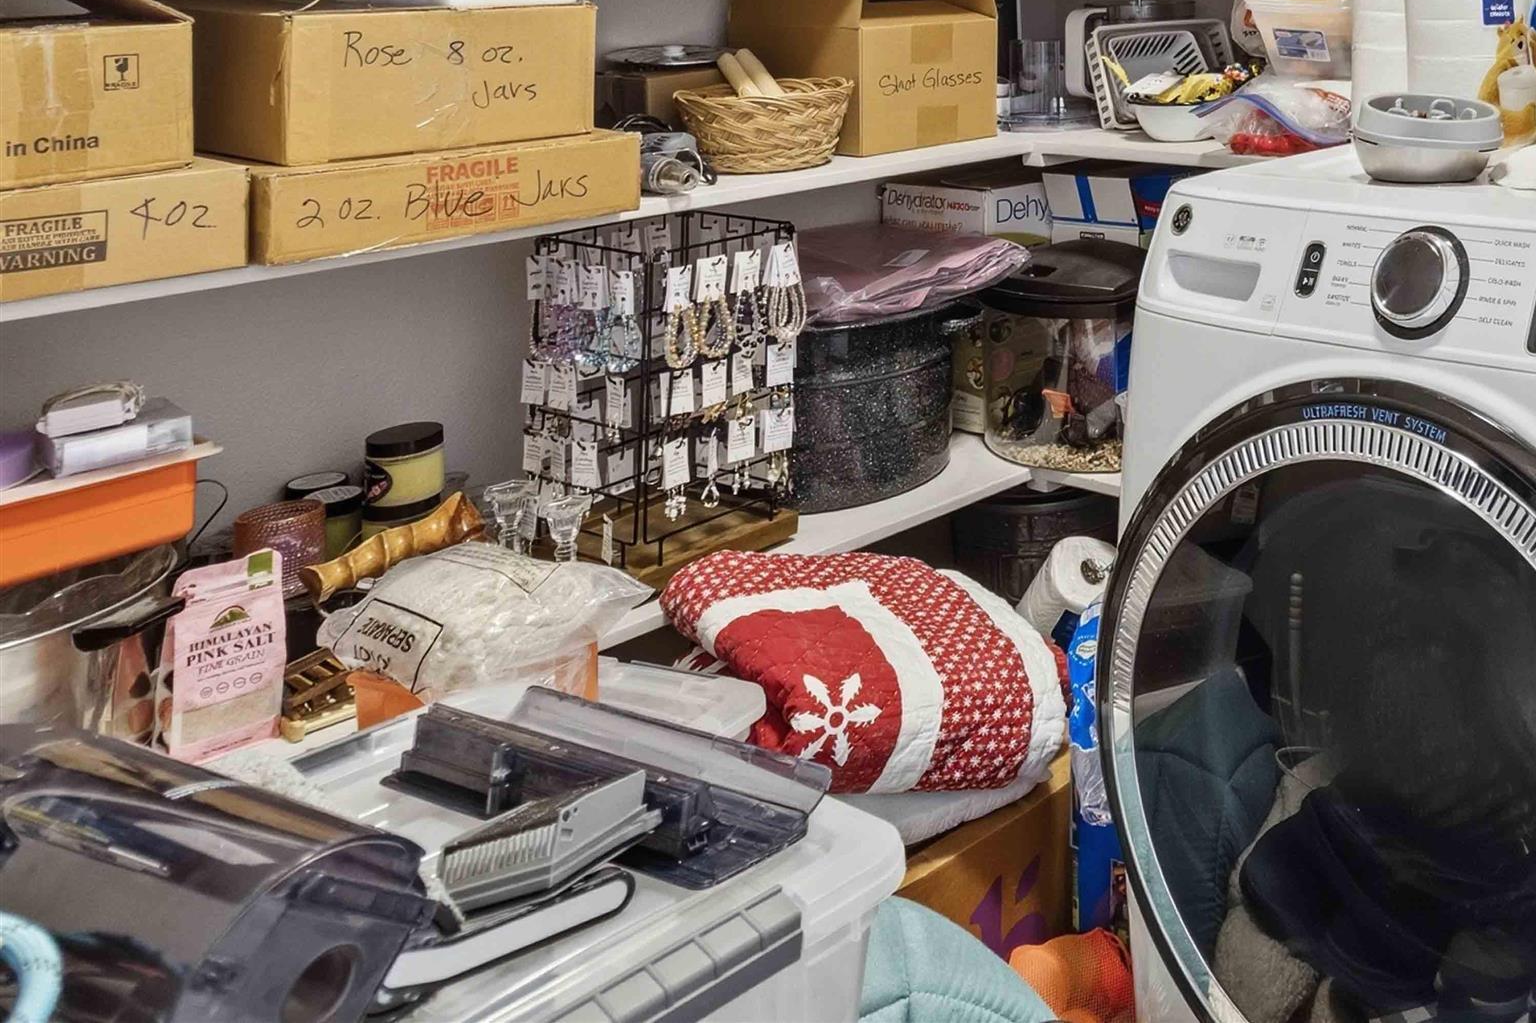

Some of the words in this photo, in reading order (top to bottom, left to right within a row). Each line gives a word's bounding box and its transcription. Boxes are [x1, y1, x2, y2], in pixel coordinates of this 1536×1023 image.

[344, 31, 412, 68] Rose
[446, 40, 465, 65] 8
[879, 72, 918, 96] Shot
[923, 68, 982, 89] Glasses
[6, 141, 27, 157] in
[34, 134, 99, 154] China
[426, 157, 519, 183] FRAGILE
[296, 200, 324, 228] 2
[405, 180, 493, 220] Blue
[511, 170, 588, 206] Jars
[888, 189, 946, 210] Dehydrator
[996, 195, 1048, 223] Dehy
[5, 217, 82, 236] FRAGILE
[1303, 406, 1367, 421] ULTRAFRESH
[1371, 410, 1399, 426] VENT
[1404, 416, 1447, 443] SYSTEM
[186, 647, 228, 667] PINK
[233, 632, 276, 653] SALT
[188, 622, 275, 653] HIMALAYAN
[198, 662, 224, 675] FINE
[226, 649, 265, 666] GRAIN
